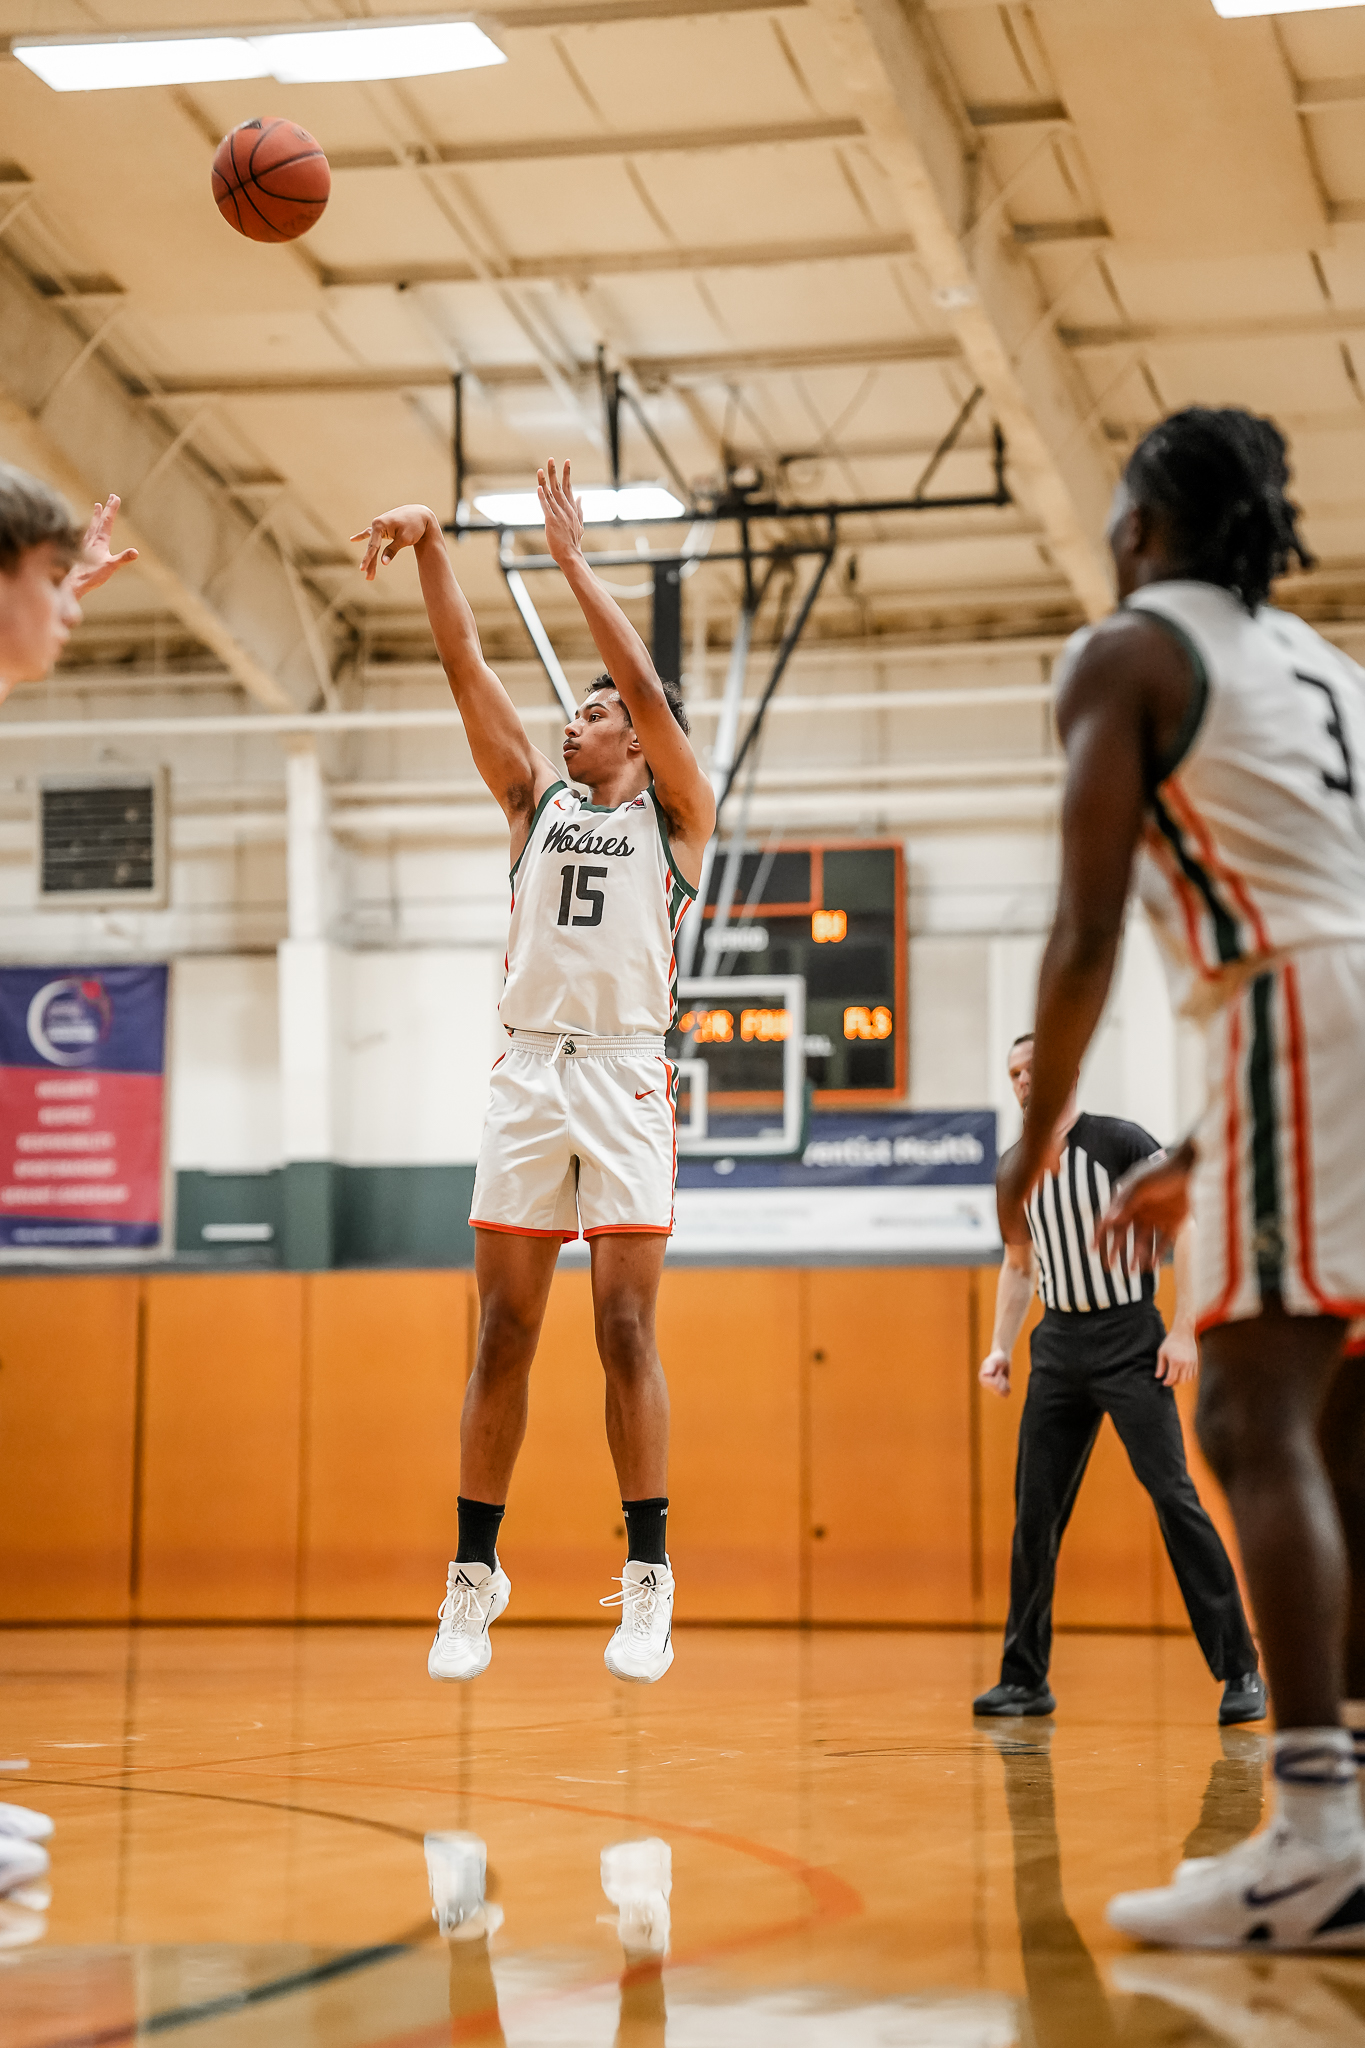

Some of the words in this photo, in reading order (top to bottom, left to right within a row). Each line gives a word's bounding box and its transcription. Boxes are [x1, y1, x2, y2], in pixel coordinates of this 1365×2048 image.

[1294, 669, 1354, 797] 3
[541, 821, 635, 857] Wolves
[557, 864, 608, 927] 15
